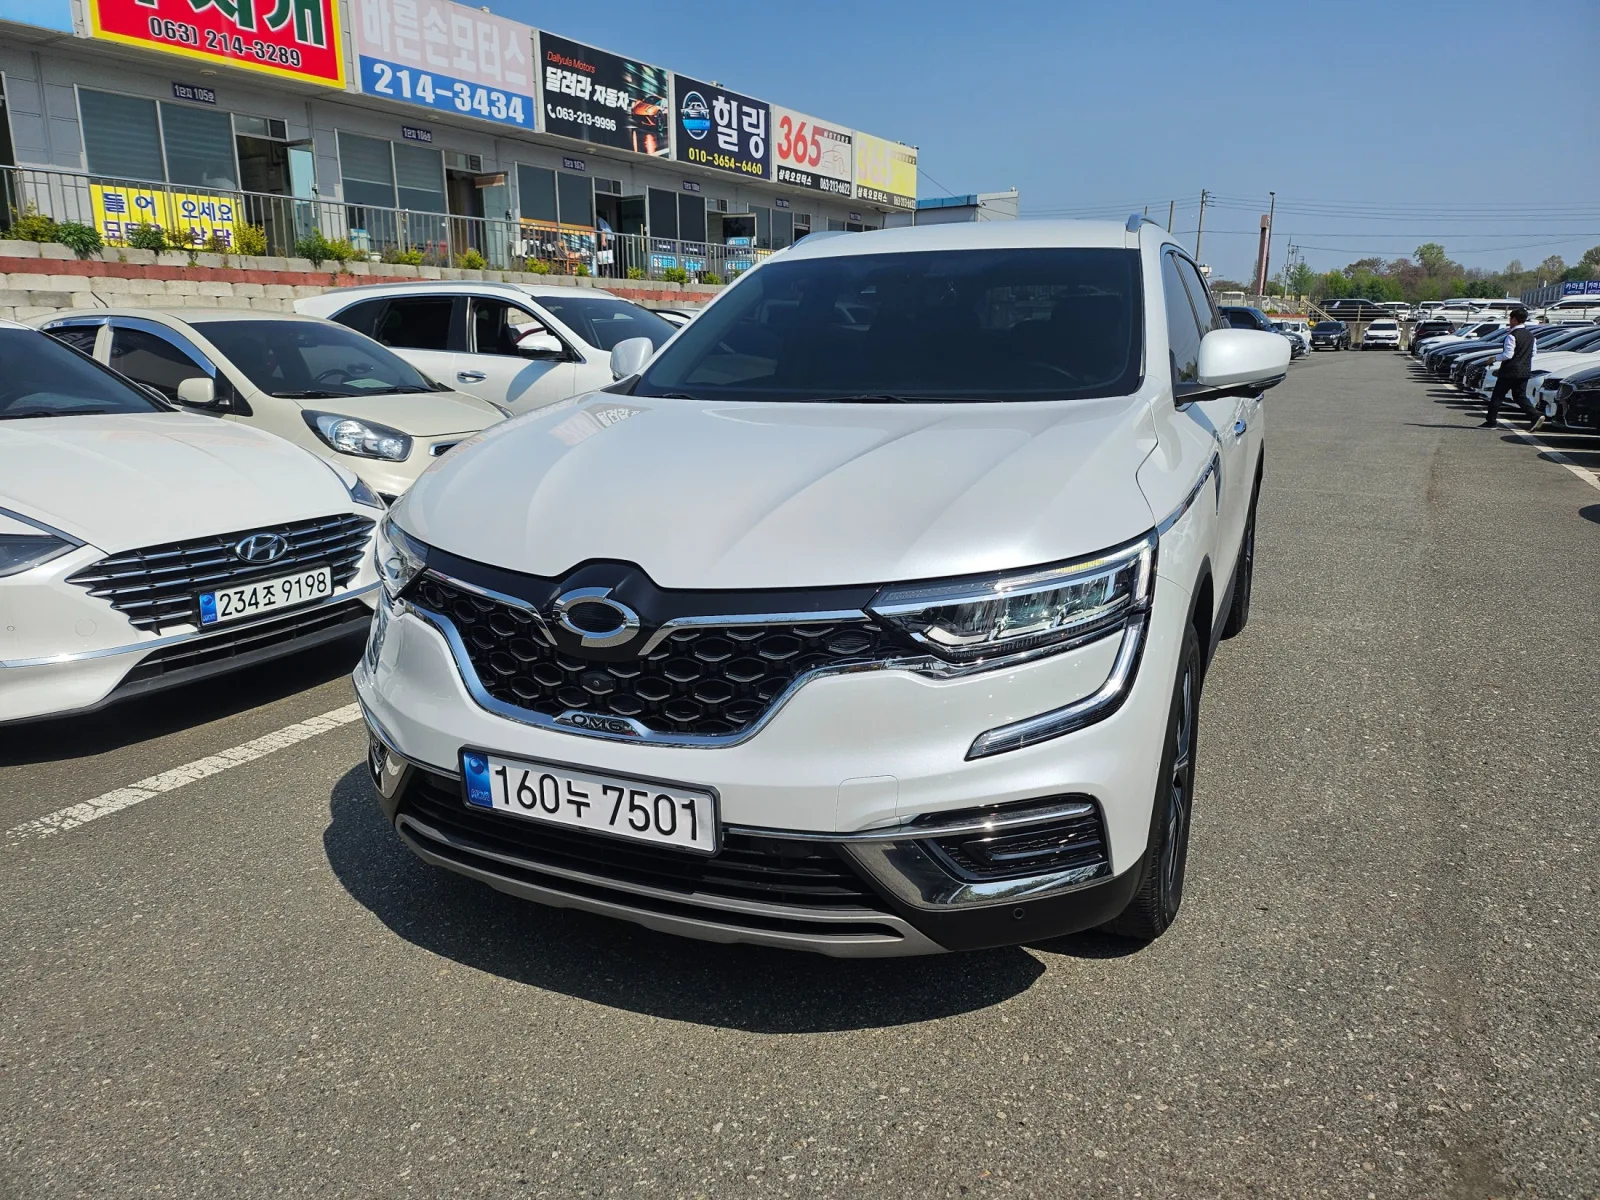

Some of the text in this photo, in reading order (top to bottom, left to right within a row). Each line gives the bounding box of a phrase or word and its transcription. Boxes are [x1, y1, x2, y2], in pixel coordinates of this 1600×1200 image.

[149, 16, 302, 67] 063) 214-3289
[361, 0, 527, 86] 바른손모터스
[546, 66, 630, 111] 달려라 자동차
[573, 59, 596, 74] Motors
[373, 63, 524, 123] 214-3434
[556, 106, 616, 131] 063-213-9996
[712, 95, 766, 159] 힐링
[777, 115, 849, 167] 365 MOTORS
[688, 147, 762, 175] 010-3654-6460
[778, 169, 850, 195] 삼육오모터스 063-213-6622
[181, 200, 233, 221] 오세요
[857, 187, 887, 203] 삼육오모터스
[219, 572, 327, 617] 234조 9198
[495, 765, 698, 841] 160누 7501
